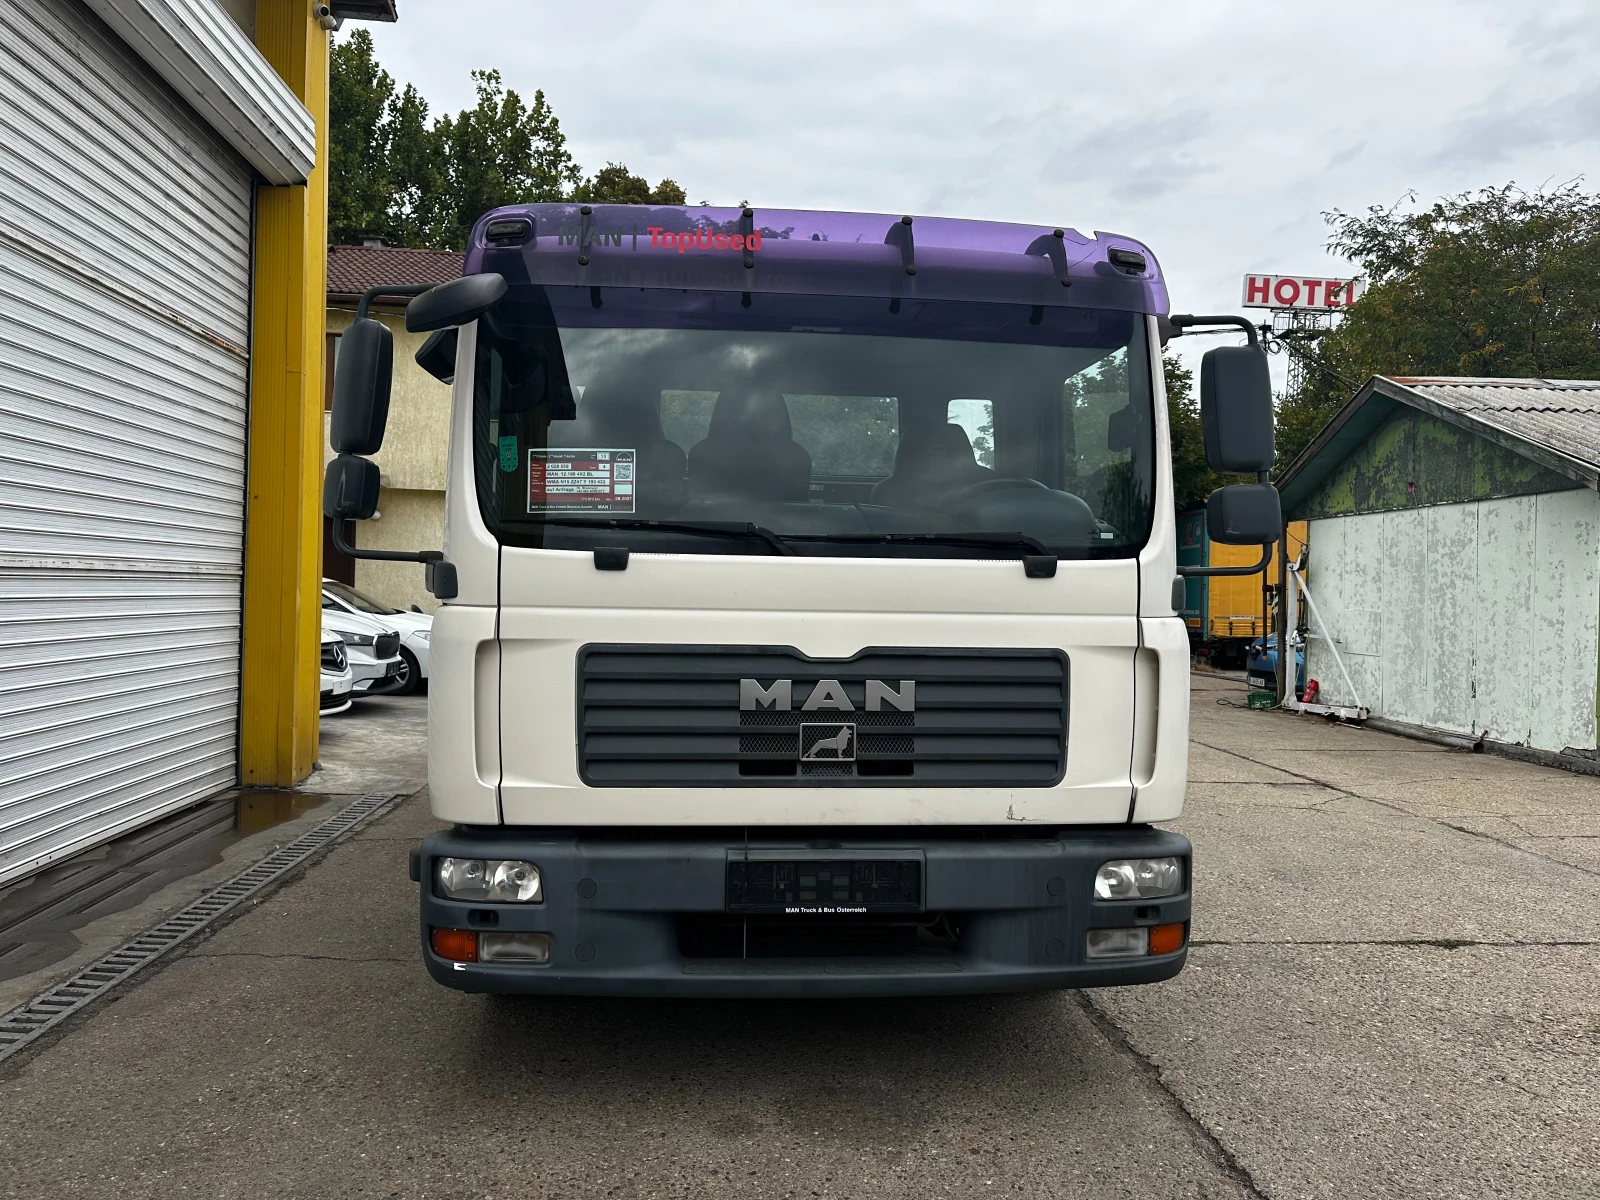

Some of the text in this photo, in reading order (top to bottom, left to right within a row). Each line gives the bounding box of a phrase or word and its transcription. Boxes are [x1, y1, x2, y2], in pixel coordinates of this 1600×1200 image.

[558, 225, 761, 253] MAN TopUsed
[1247, 277, 1358, 307] HOTEL
[740, 679, 915, 711] MAN
